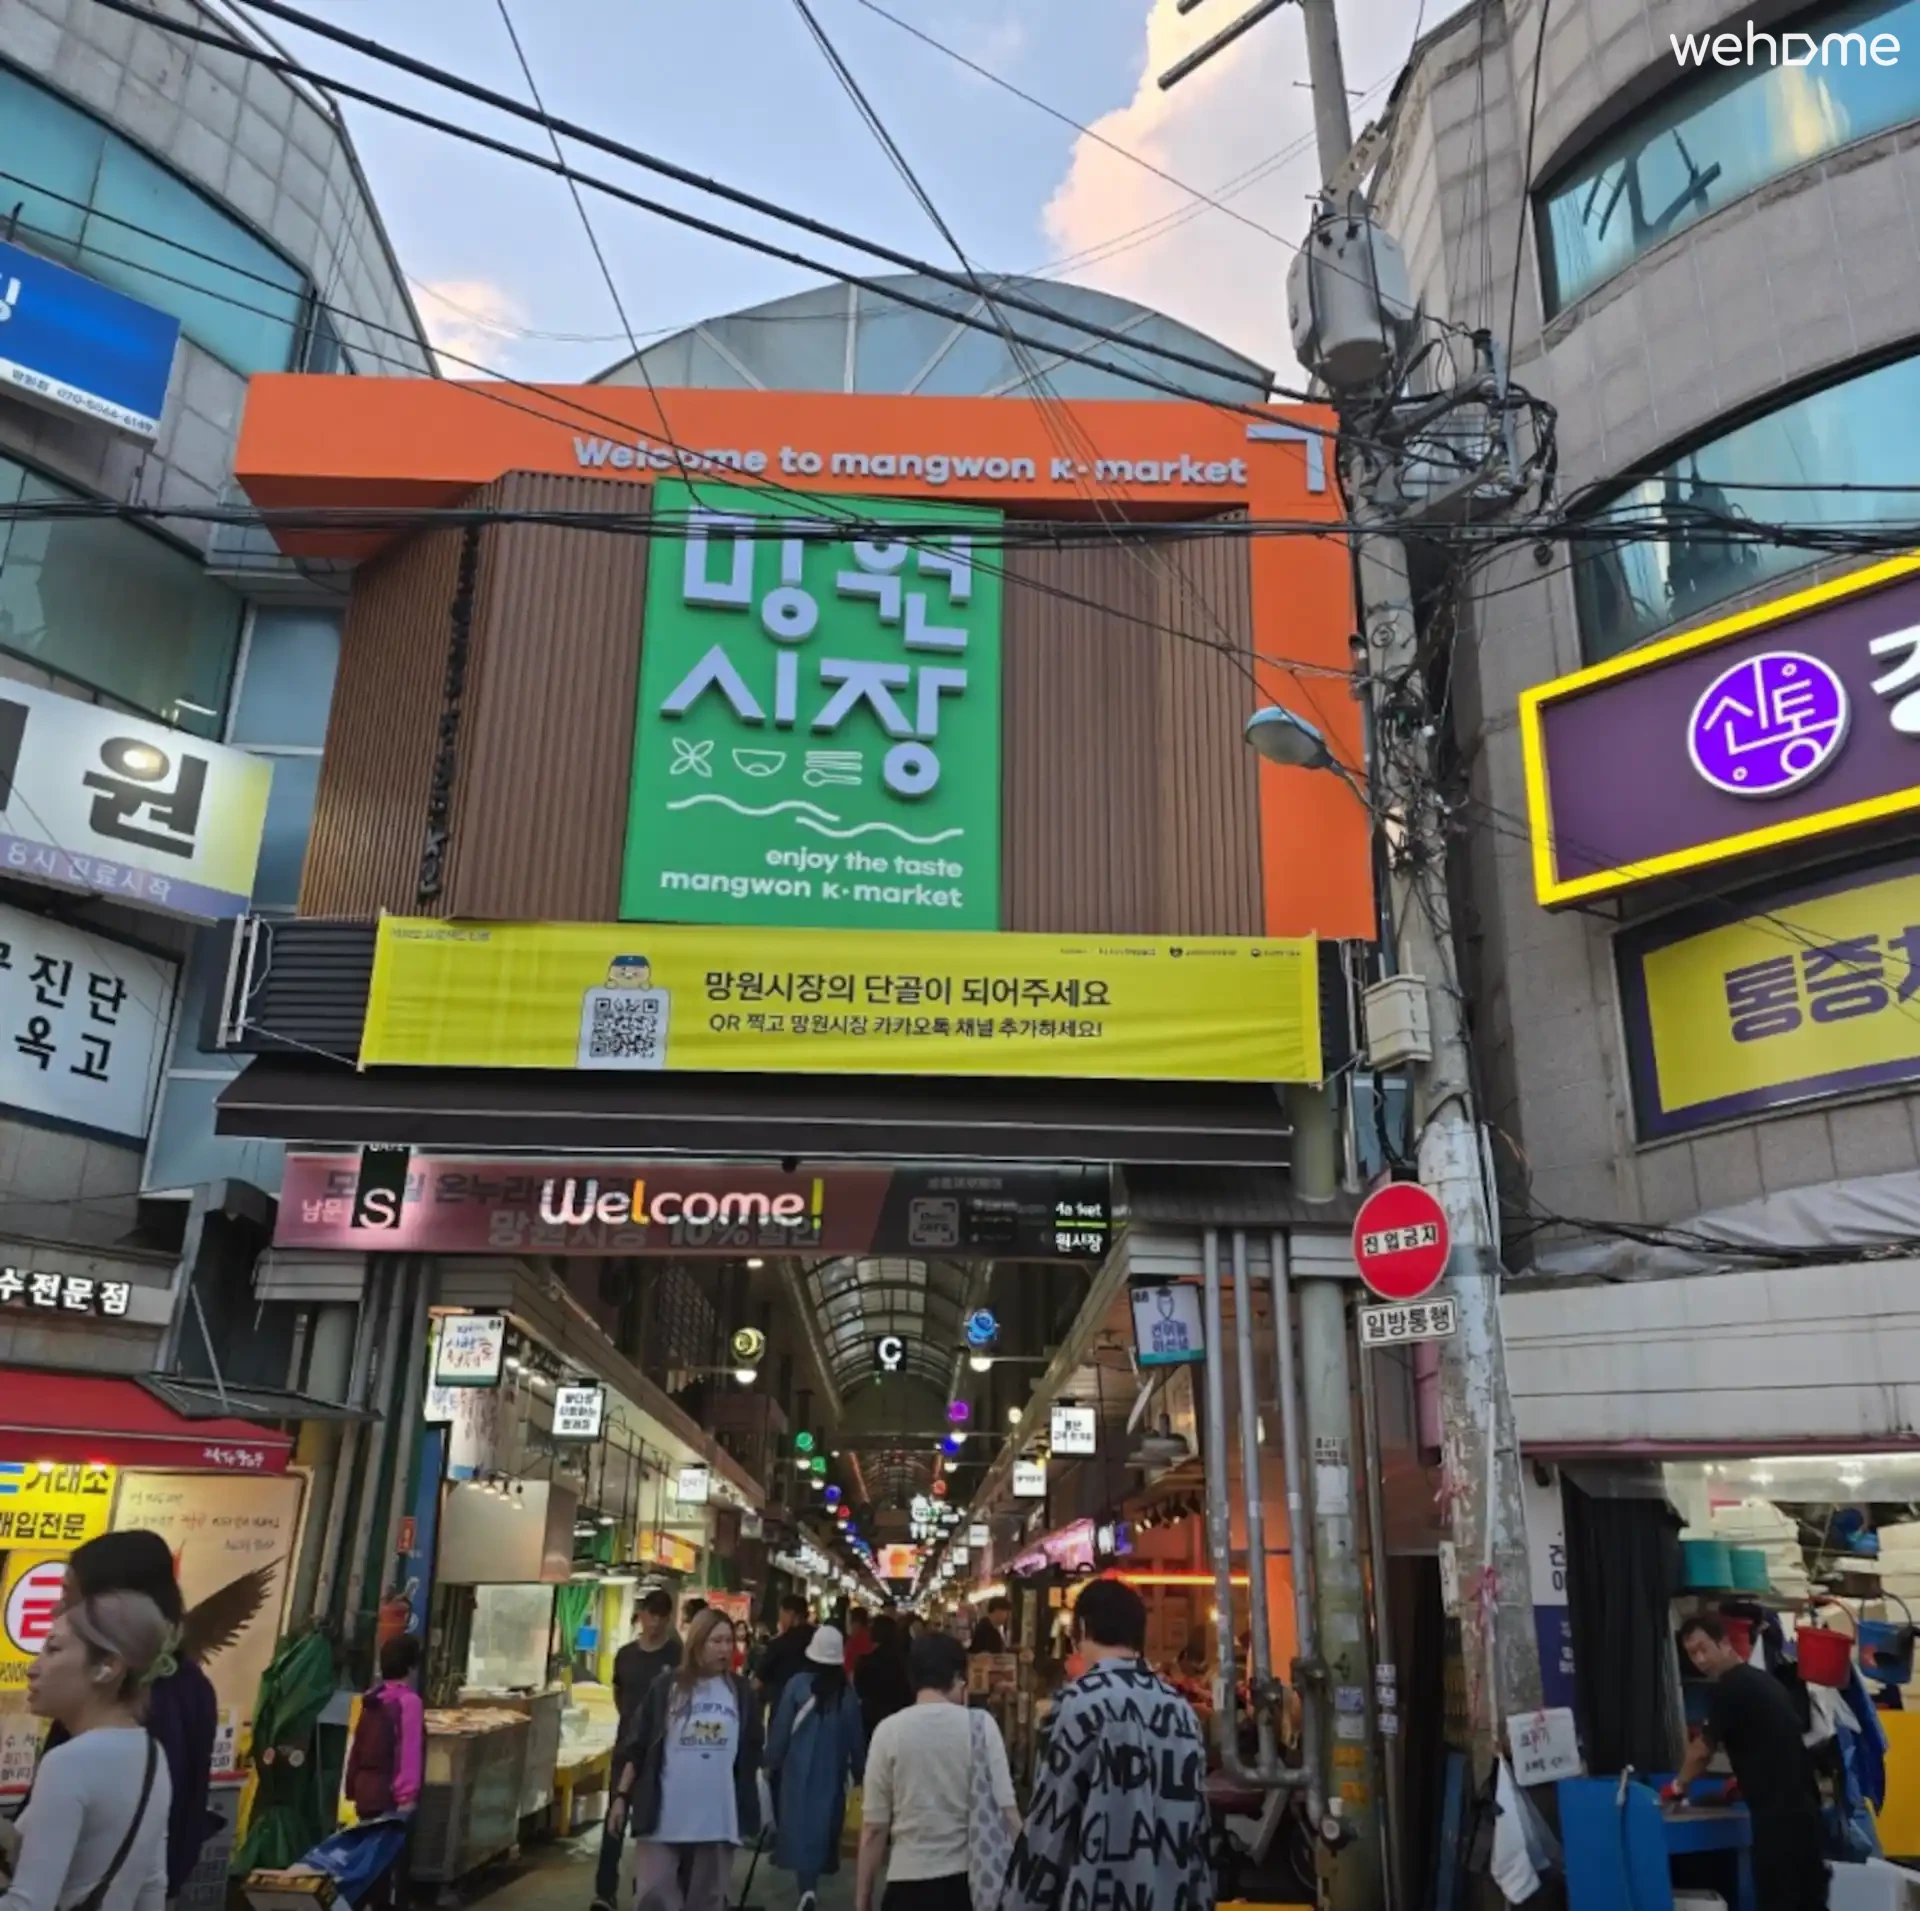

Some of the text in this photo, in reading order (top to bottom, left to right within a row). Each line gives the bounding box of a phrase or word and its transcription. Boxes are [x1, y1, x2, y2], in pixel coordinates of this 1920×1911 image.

[572, 436, 766, 474] Welcome
[778, 445, 822, 476] to
[831, 452, 1035, 486] mangwon
[682, 505, 972, 654] 망원
[659, 644, 968, 800] 시장
[765, 846, 963, 878] enjoy the taste
[660, 870, 812, 900] mangwon
[0, 941, 127, 1025] 진단
[705, 971, 1111, 1007] 망원시장의 단골이 되어주세요
[709, 1013, 1102, 1039] QR 찍고 망원시장 카카오톡 채널 추가하세요!
[359, 1187, 397, 1229] S
[540, 1178, 824, 1230] Welcome!
[1364, 1225, 1437, 1254] 진입금지
[1366, 1305, 1449, 1338] 일방통행
[879, 1337, 902, 1363] C
